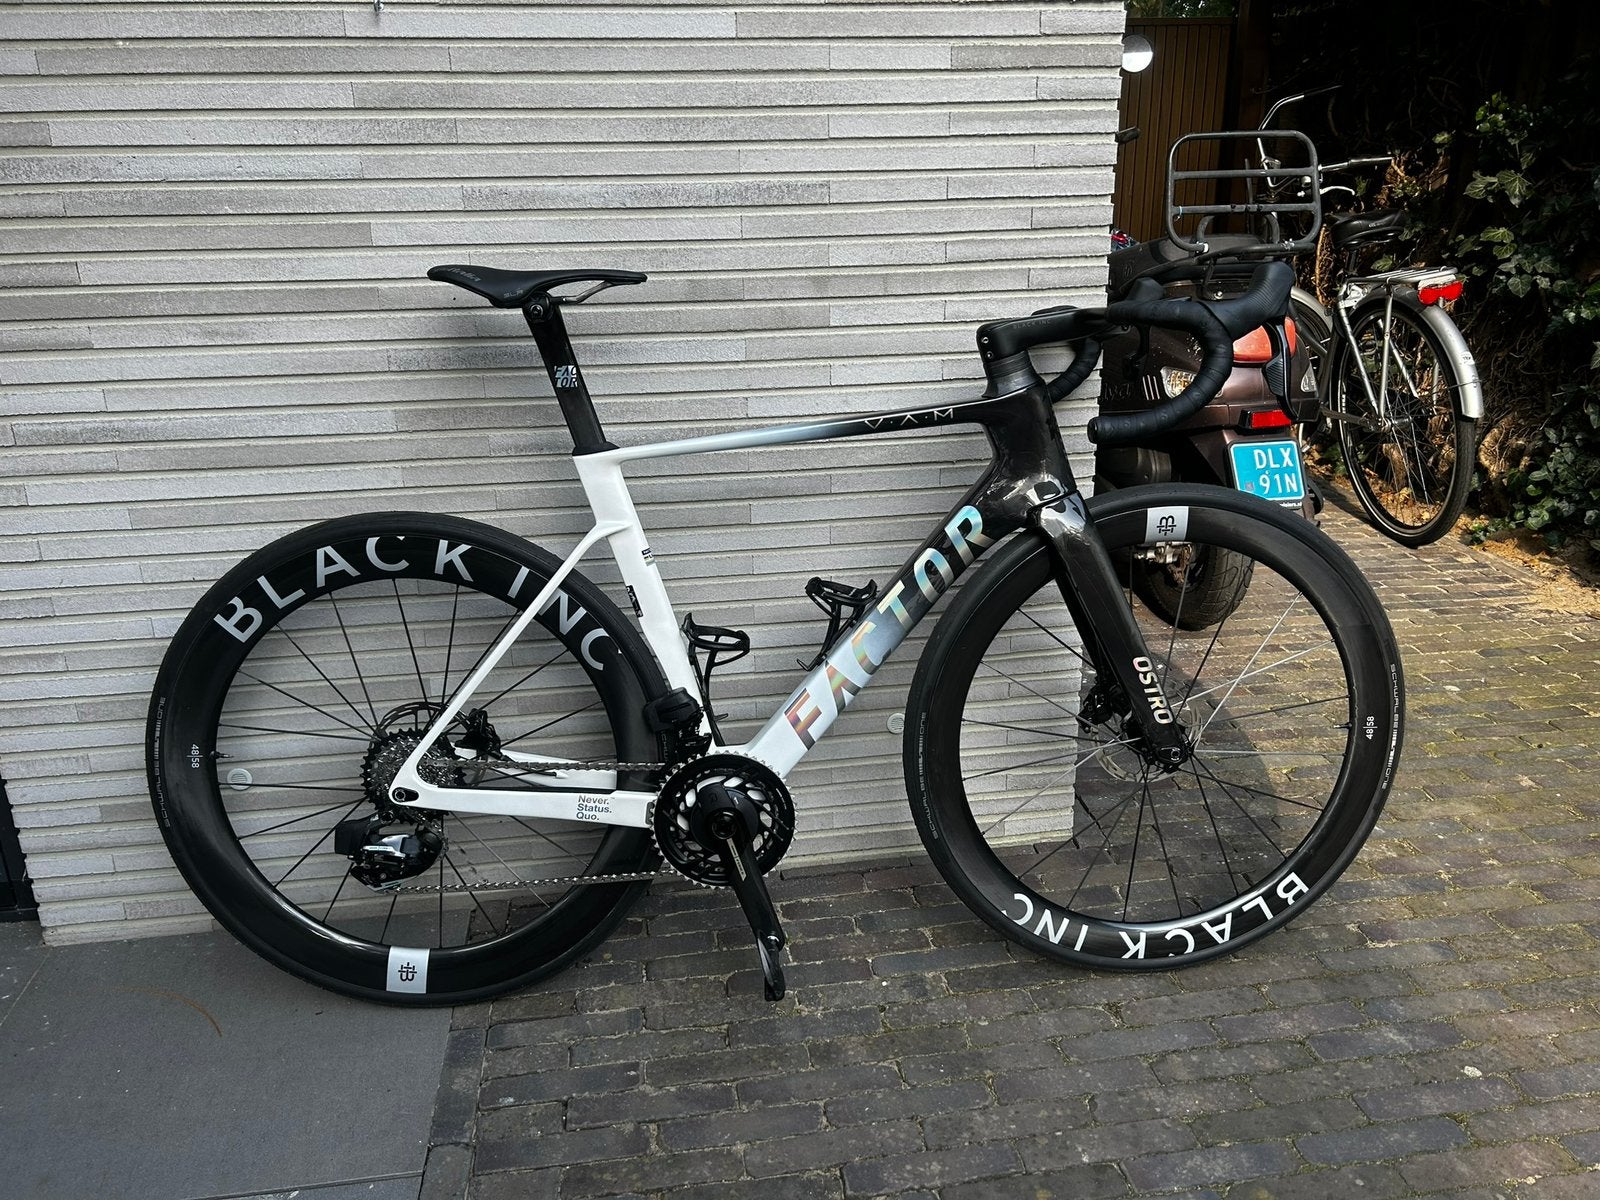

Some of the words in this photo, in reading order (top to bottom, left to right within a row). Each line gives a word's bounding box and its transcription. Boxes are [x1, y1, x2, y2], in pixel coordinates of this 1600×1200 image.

[1253, 447, 1294, 469] DLX
[1259, 472, 1298, 495] 91N
[213, 536, 474, 643] BLACK
[506, 566, 623, 672] INC
[784, 504, 996, 751] FACTOR
[1131, 655, 1173, 726] OSTRO
[576, 803, 613, 813] Status.
[576, 811, 600, 821] Quo.
[578, 795, 610, 805] Never.
[1000, 892, 1089, 952] INC
[1119, 871, 1309, 960] BLACK
